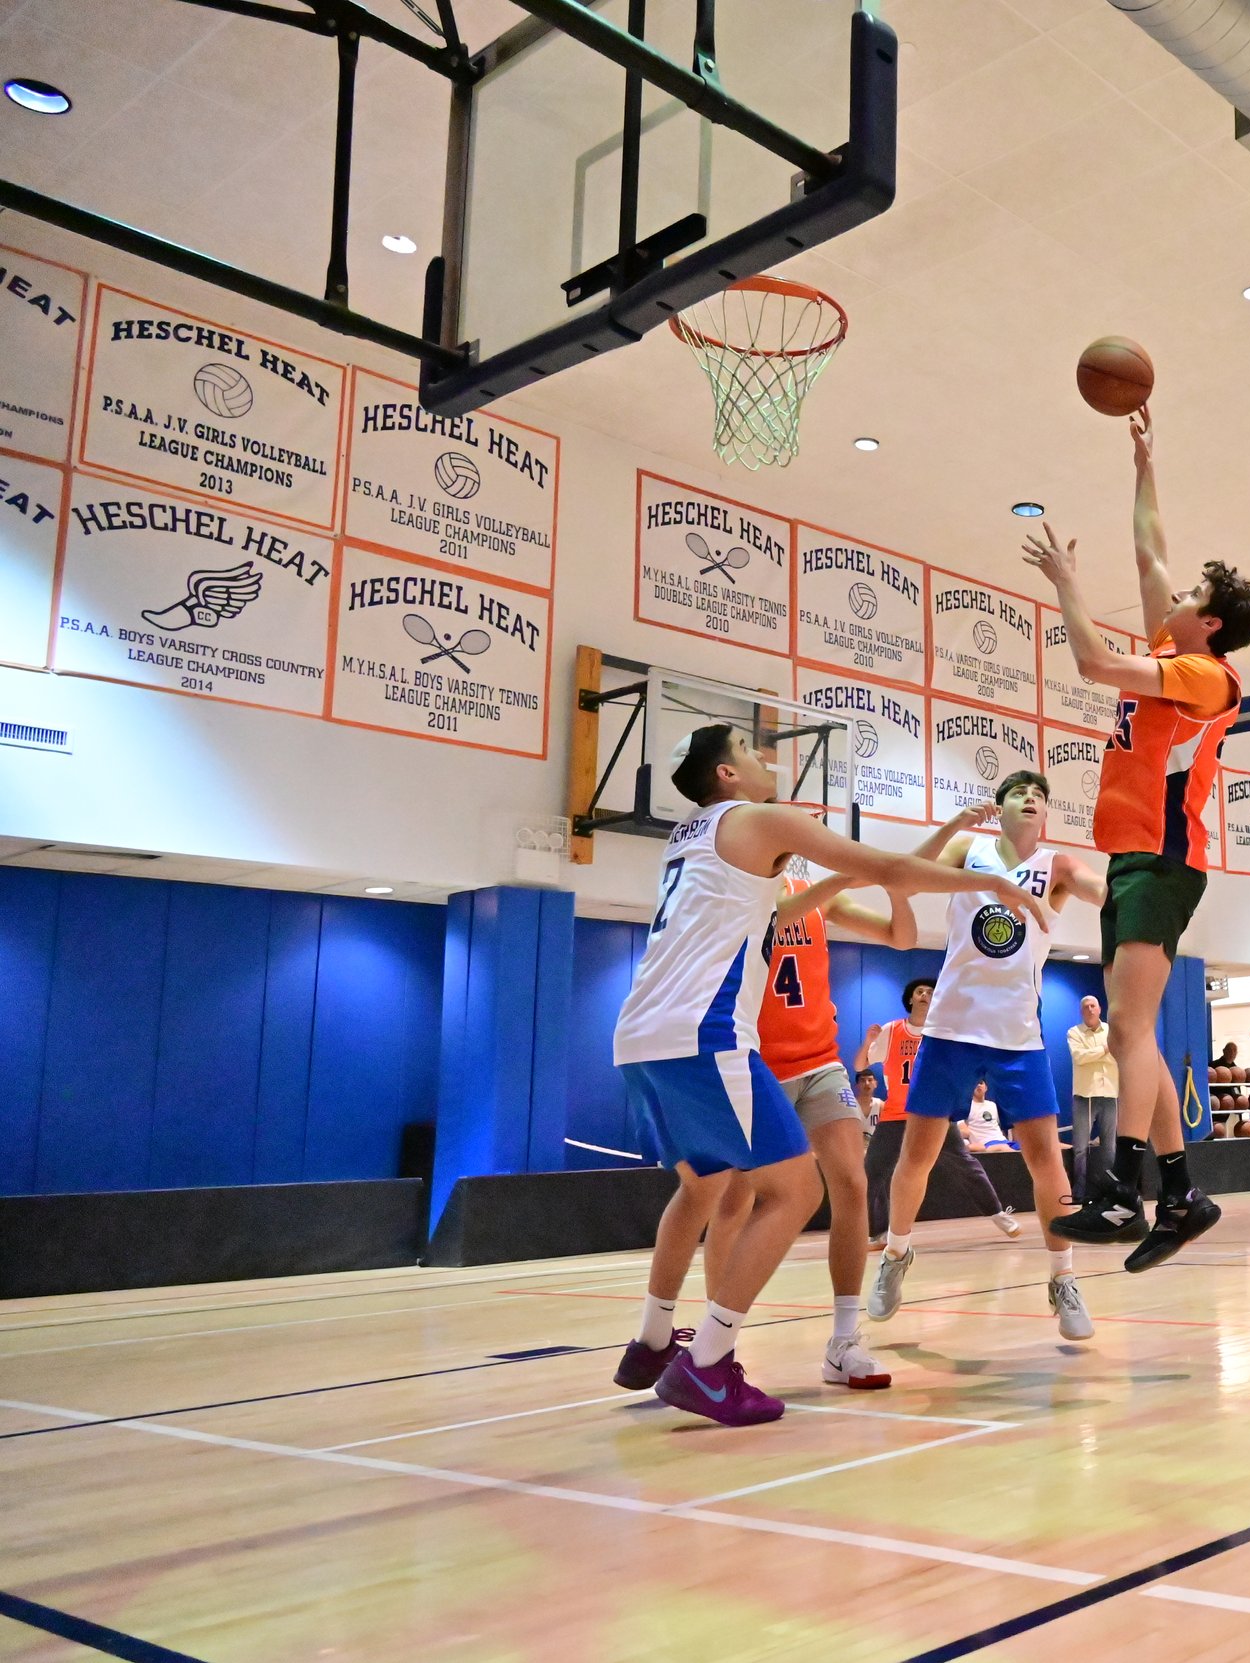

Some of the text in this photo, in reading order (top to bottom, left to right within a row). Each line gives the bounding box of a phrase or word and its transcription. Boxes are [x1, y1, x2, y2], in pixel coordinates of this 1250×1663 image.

[0, 267, 76, 326] EAT
[111, 320, 330, 407] HESCHEL HEAT
[0, 403, 64, 426] HAMPIONS
[103, 395, 327, 476] P.S.A.A. J.V. GIRLS VOLLEYBALL
[362, 403, 549, 489] HESCHEL HEAT
[139, 431, 293, 488] LEAGUE CHAMPIONS
[199, 473, 233, 494] 2013
[391, 508, 516, 556] LEAGUE CHAMPIONS
[407, 494, 427, 513] J.V.
[432, 502, 471, 525] GIRLS
[475, 513, 551, 549] VOLLEYBALL
[647, 501, 785, 568] HESCHEL HEAT
[72, 502, 330, 586] HESCHEL HEAT
[440, 539, 468, 560] 2011
[803, 547, 920, 606] HESCHEL HEAT
[197, 611, 211, 622] CC
[348, 576, 540, 652] HESCHEL HEAT
[654, 585, 777, 630] DOUBLES LEAGUE CHAMPIONS
[693, 580, 718, 598] GIRLS
[720, 586, 756, 608] VARSITY
[759, 596, 787, 618] TENNIS
[935, 589, 995, 615] HESCHEL
[999, 600, 1033, 641] HEAT
[705, 614, 730, 633] 2010
[849, 622, 873, 641] GIRLS
[875, 629, 924, 654] VOLLEYBALL
[60, 617, 325, 679] P.S.A.A. BOYS VARSITY CROSS COUNTRY
[823, 630, 903, 662] LEAGUE CHAMPIONS
[853, 652, 874, 668] 2010
[128, 648, 266, 685] LEAGUE CHAMPIONS
[181, 676, 213, 692] 2014
[953, 665, 1018, 693] LEAGUE CHAMPIONS
[956, 652, 981, 670] VARSITY
[983, 661, 1001, 676] GIRLS
[1002, 664, 1036, 685] VOLLEYBALL
[385, 684, 501, 721] LEAGUE CHAMPIONS
[414, 670, 443, 691] BOYS
[447, 677, 495, 700] VARSITY
[499, 688, 539, 710] TENNIS
[1061, 696, 1084, 711] LEAGUE
[428, 712, 458, 732] 2011
[881, 695, 921, 739] HEAT
[936, 715, 1035, 762] HESCHEL HEAT
[1047, 741, 1100, 768] HESCHEL
[858, 780, 903, 798] CHAMPIONS
[861, 765, 882, 780] GIRLS
[884, 768, 925, 788] VOLLEYBALL
[855, 792, 874, 807] 2010
[1063, 813, 1087, 828] LEAGUE
[652, 856, 686, 934] 2
[1016, 869, 1048, 898] 25
[980, 907, 1002, 921] TEAM
[772, 953, 805, 1009] 4
